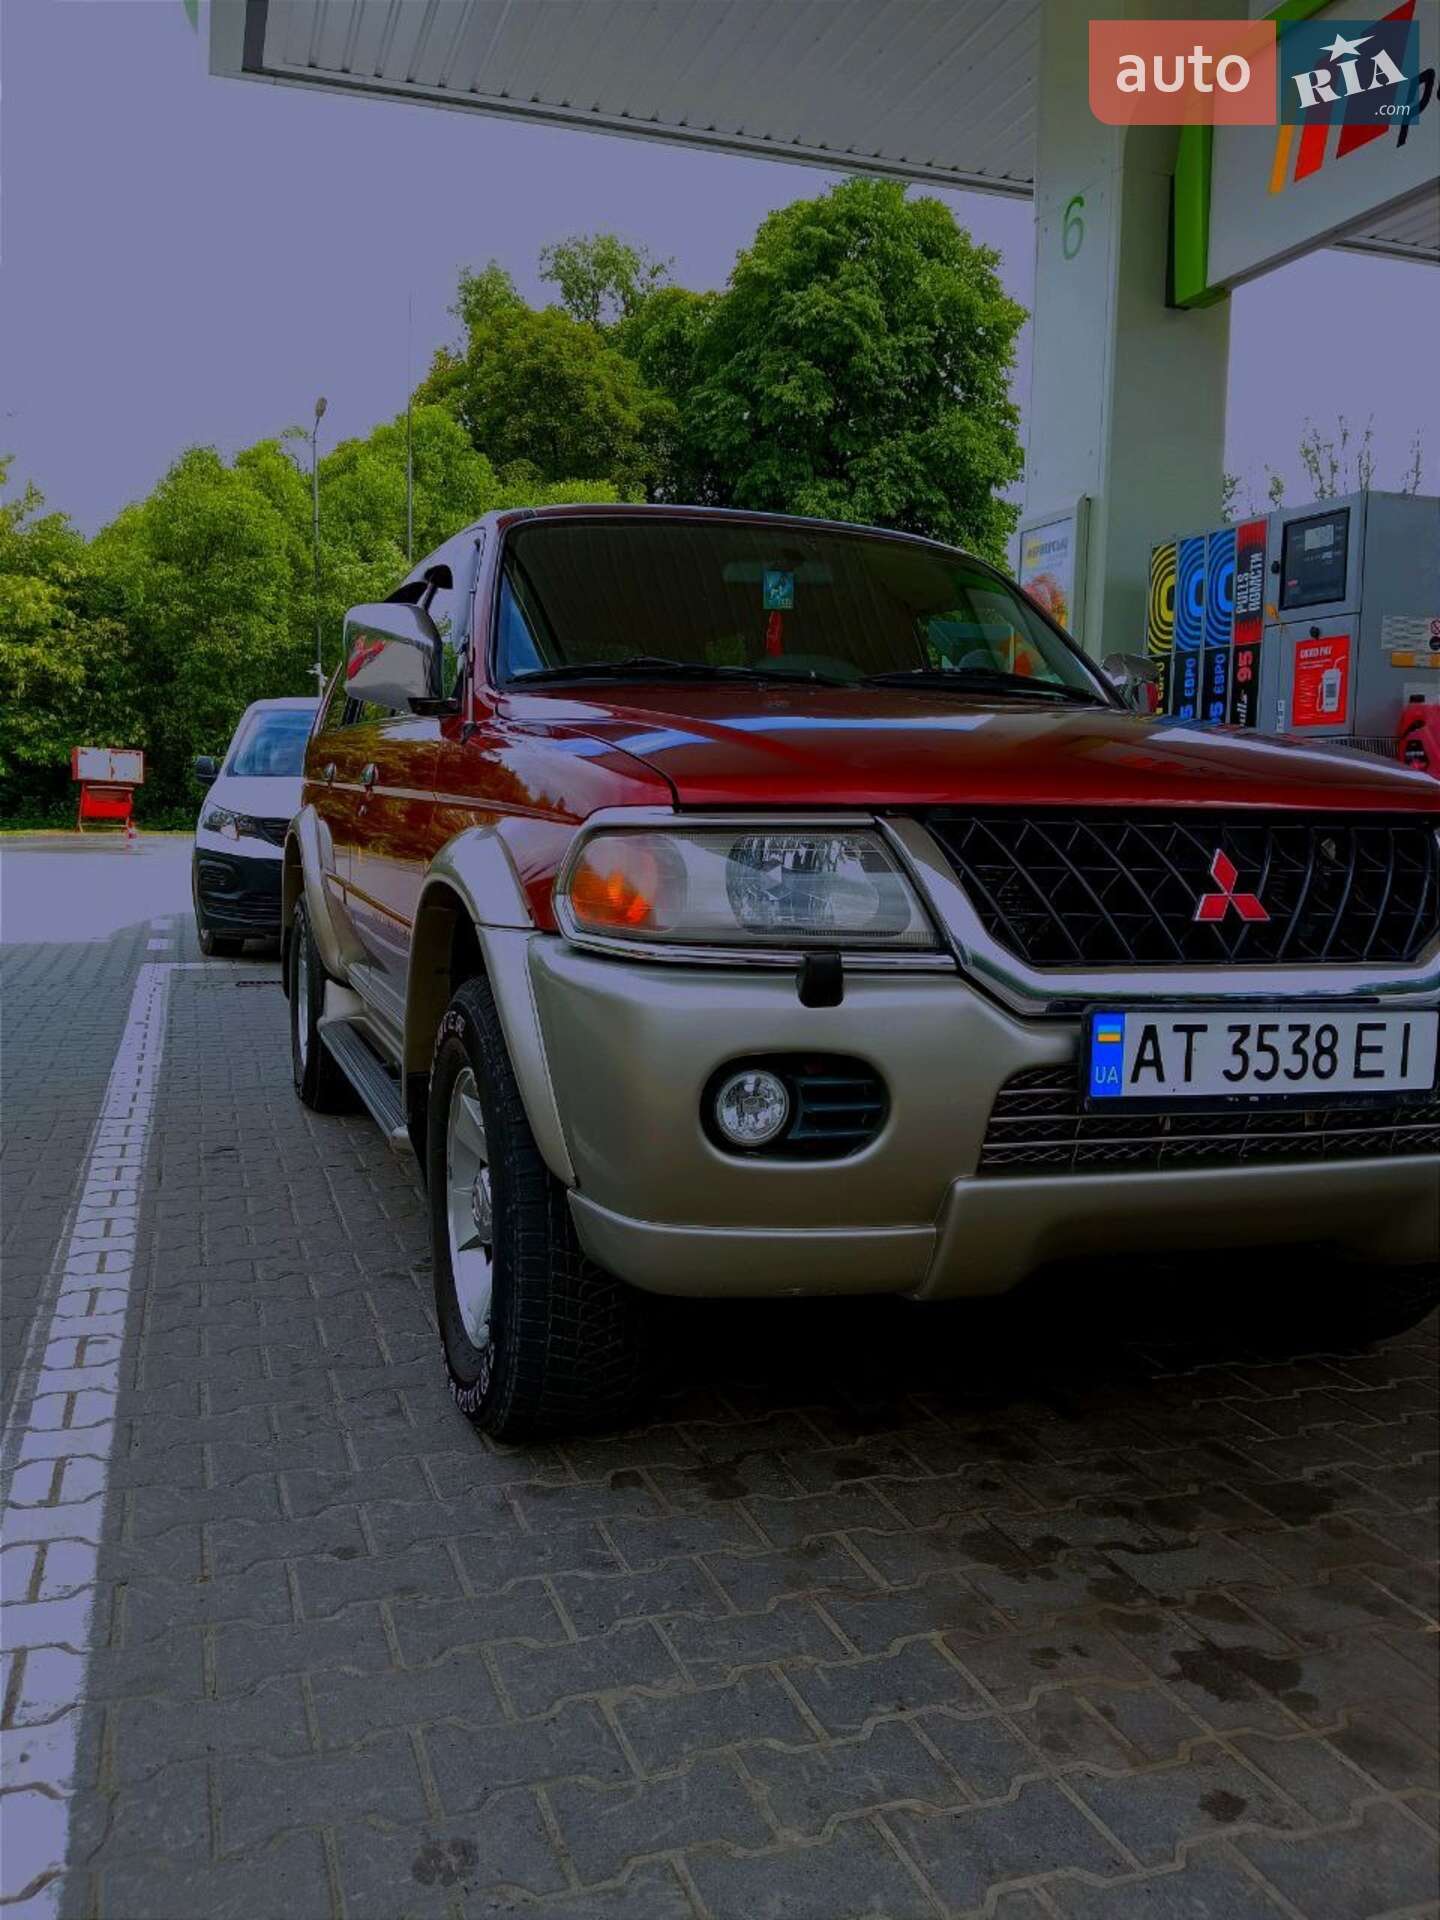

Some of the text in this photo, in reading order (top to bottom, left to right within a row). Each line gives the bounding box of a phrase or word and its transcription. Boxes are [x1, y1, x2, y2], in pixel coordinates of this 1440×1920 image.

[1062, 195, 1085, 261] 6
[1236, 572, 1249, 615] PULLS
[1236, 650, 1254, 728] ulls 95
[1094, 1065, 1119, 1085] UA
[1130, 1022, 1412, 1083] AT 3538 EI
